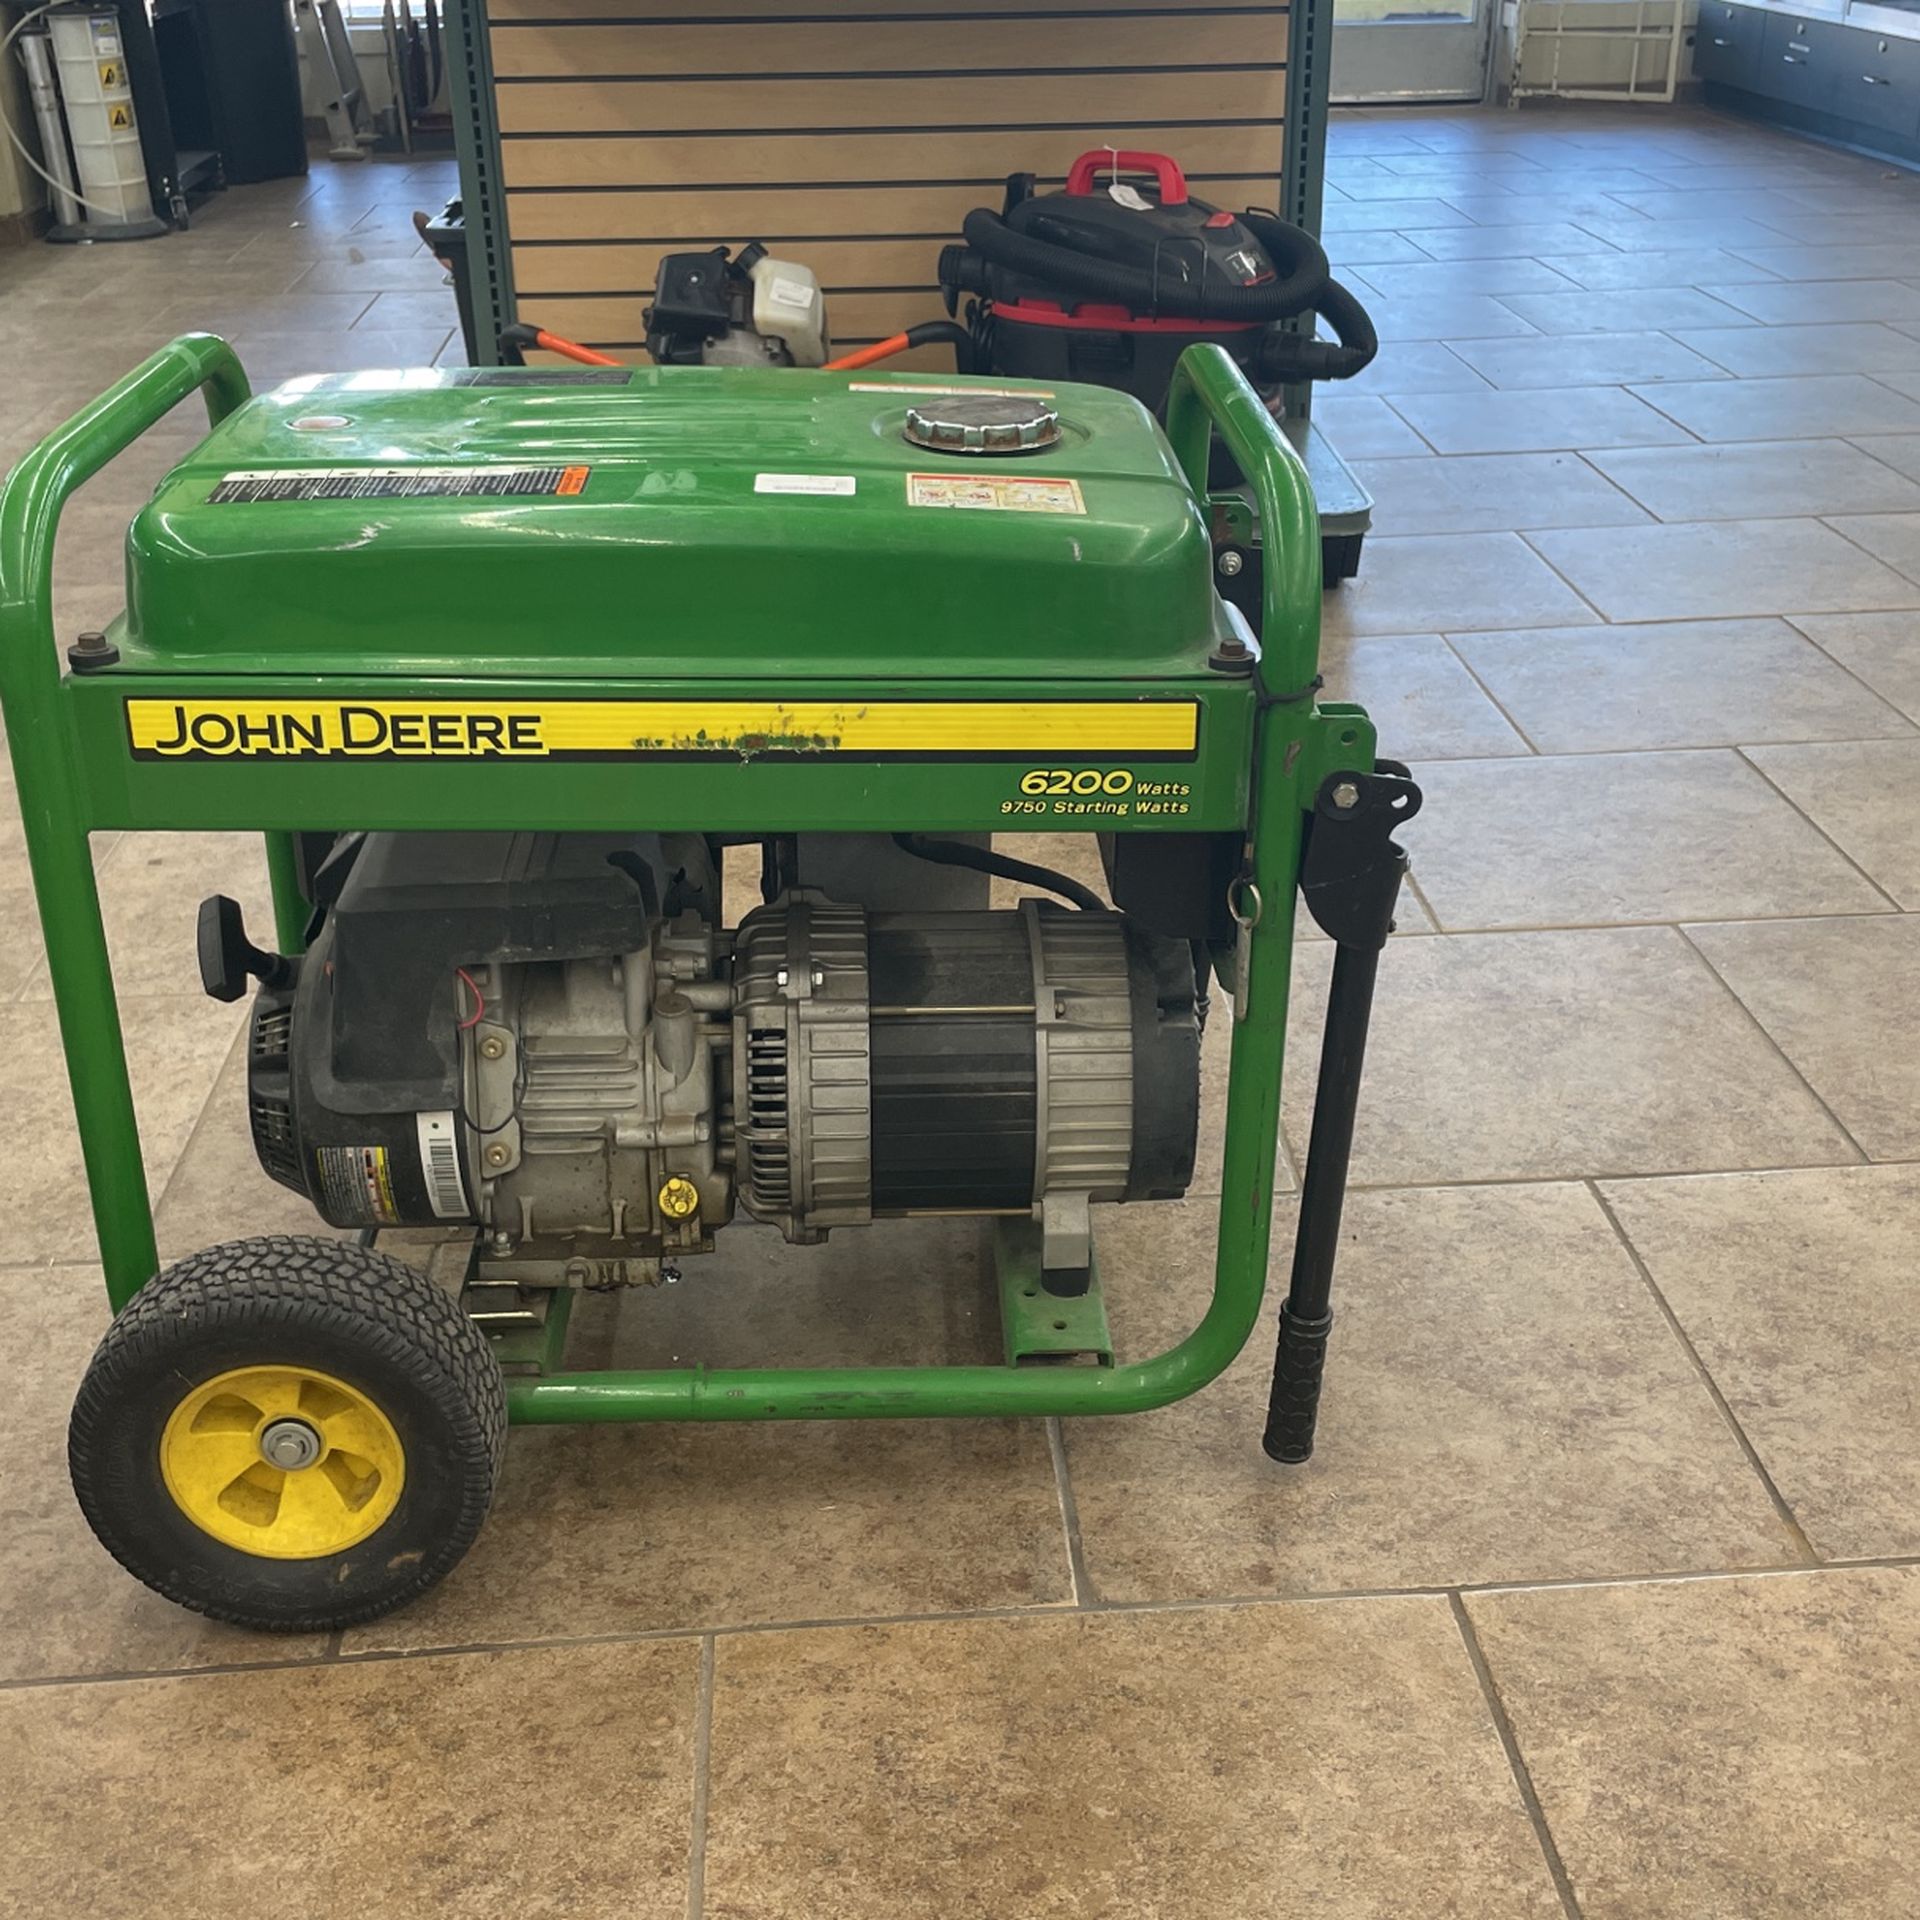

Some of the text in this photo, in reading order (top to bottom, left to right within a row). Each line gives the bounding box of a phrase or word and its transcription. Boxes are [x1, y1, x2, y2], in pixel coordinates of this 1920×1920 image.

[156, 706, 544, 750] JOHN DEERE
[1020, 770, 1190, 796] 6200 Watts
[1000, 801, 1190, 815] 9750 Starting Watts
